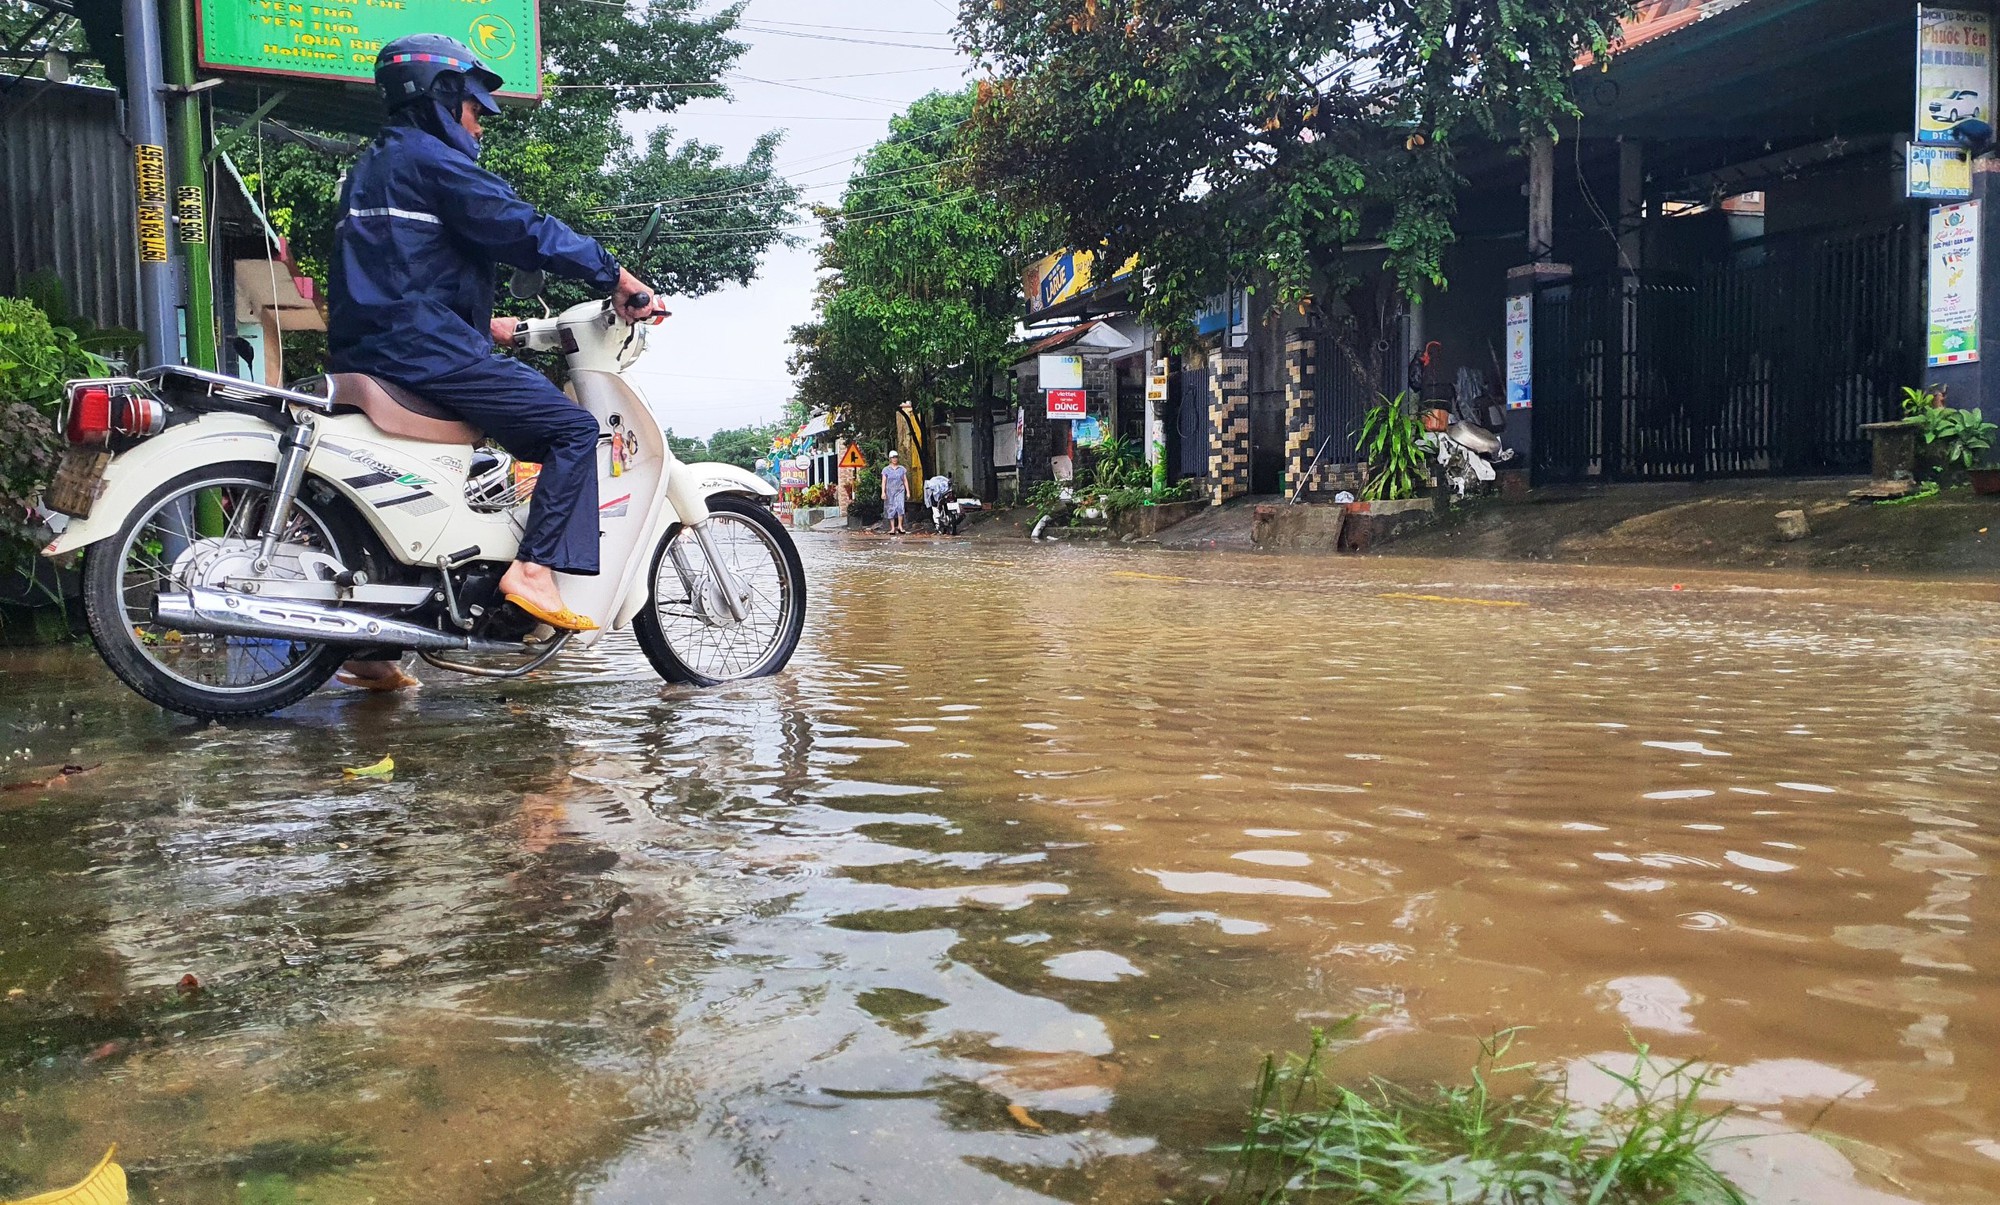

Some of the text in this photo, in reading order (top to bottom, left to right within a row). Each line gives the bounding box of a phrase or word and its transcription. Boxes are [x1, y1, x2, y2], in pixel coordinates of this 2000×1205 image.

[263, 43, 378, 64] Hotline: 09
[350, 37, 384, 51] BIẾ
[141, 145, 165, 202] 0933.032.567
[140, 205, 166, 261] 0977.624.634
[178, 187, 203, 243] 0905.686.395
[1045, 265, 1066, 303] LARUE
